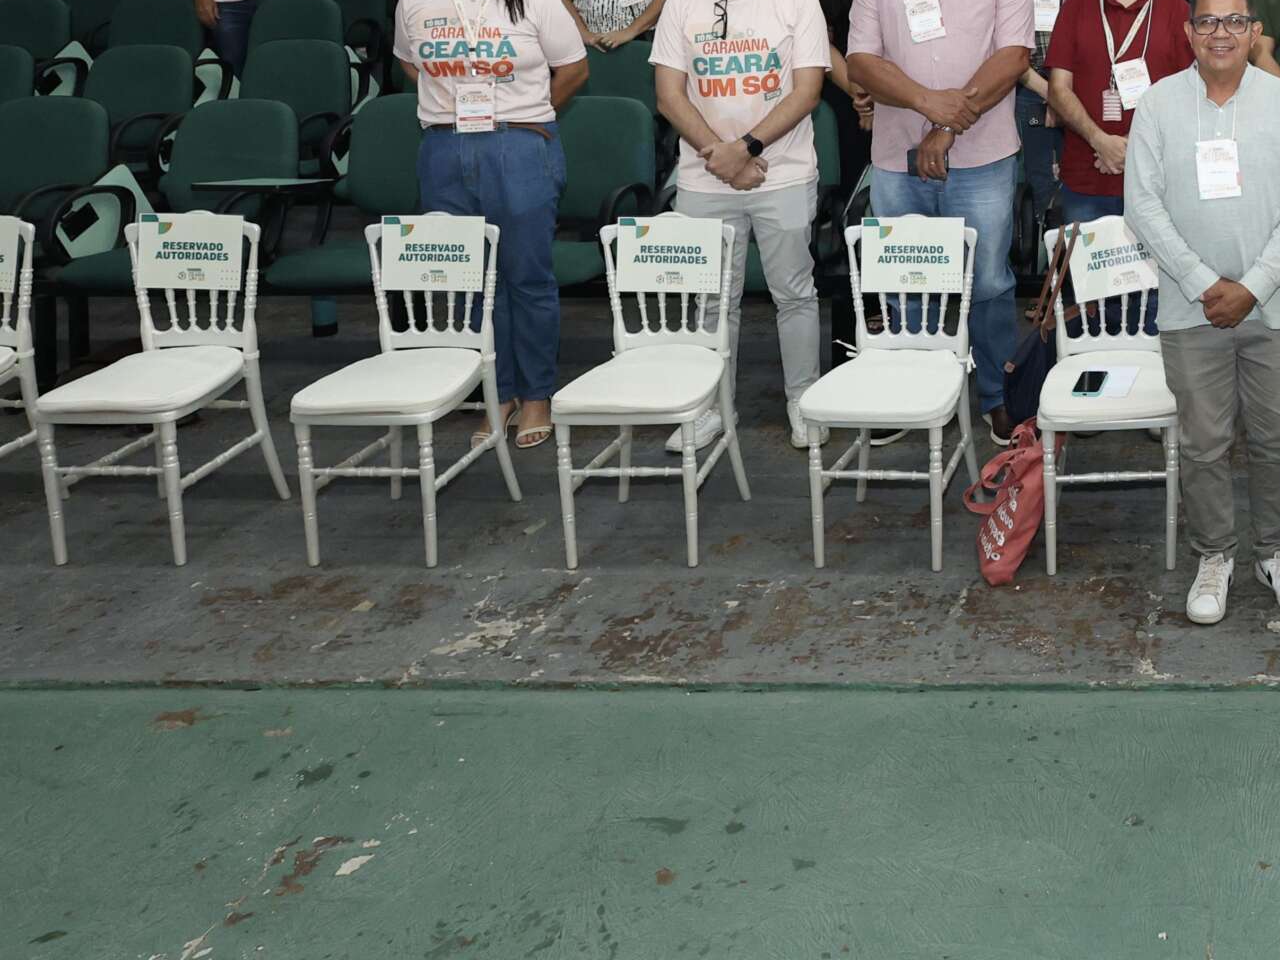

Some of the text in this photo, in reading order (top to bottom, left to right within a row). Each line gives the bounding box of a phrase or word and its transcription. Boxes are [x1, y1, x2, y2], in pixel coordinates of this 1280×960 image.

[418, 35, 517, 59] CEARÁ
[702, 38, 770, 55] CARAVANA
[422, 56, 514, 78] UM SÓ
[692, 47, 782, 76] CEARÁ
[697, 78, 737, 98] UM
[742, 68, 781, 96] SÓ
[162, 241, 224, 252] RESERVADO
[405, 243, 465, 253] RESERVADO
[640, 244, 702, 255] RESERVADO
[883, 245, 944, 254] RESERVADO
[1090, 242, 1145, 261] RESERVAD
[155, 251, 230, 262] AUTORIDADES
[398, 253, 471, 263] AUTORIDADES
[633, 254, 708, 265] AUTORIDADES
[877, 255, 950, 264] AUTORIDADES
